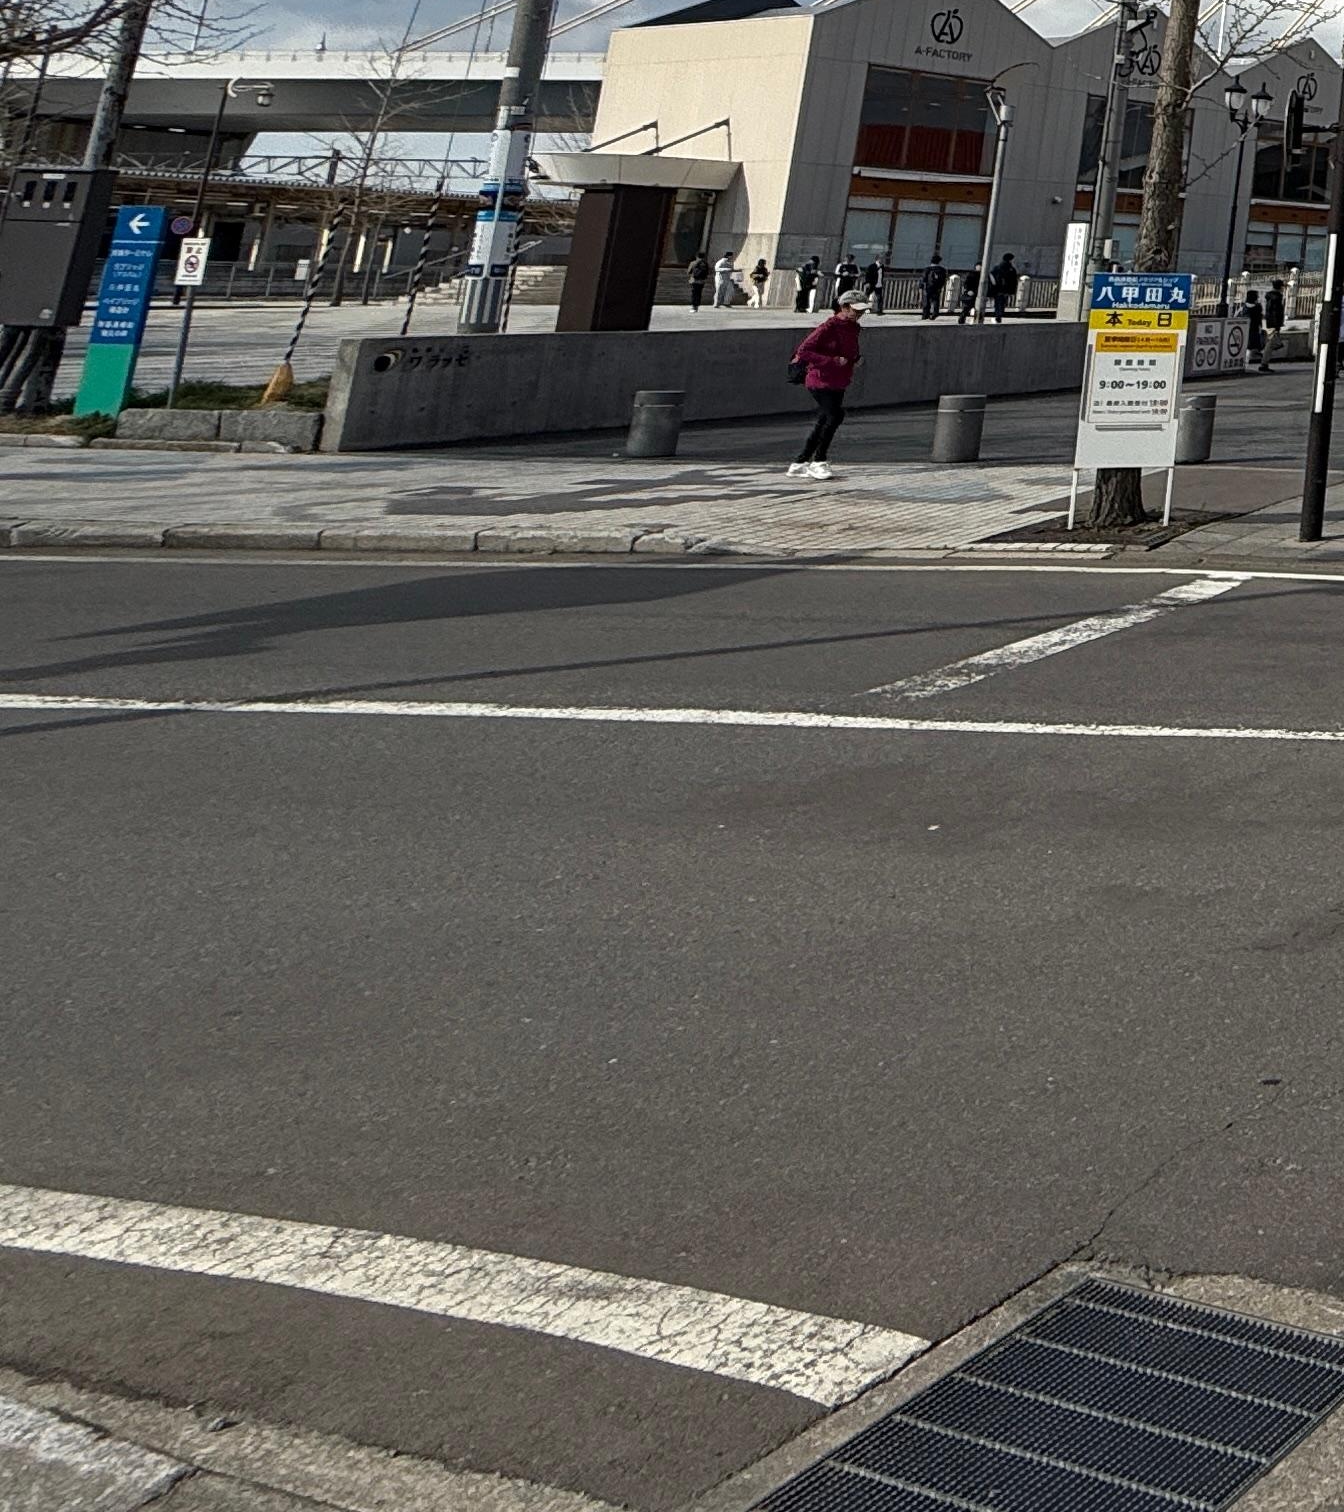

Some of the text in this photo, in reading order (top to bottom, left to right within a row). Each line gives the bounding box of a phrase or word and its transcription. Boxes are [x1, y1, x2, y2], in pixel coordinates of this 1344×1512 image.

[914, 46, 973, 62] A-FACTORY
[1096, 286, 1186, 304] 八甲田丸
[1127, 319, 1152, 327] Today
